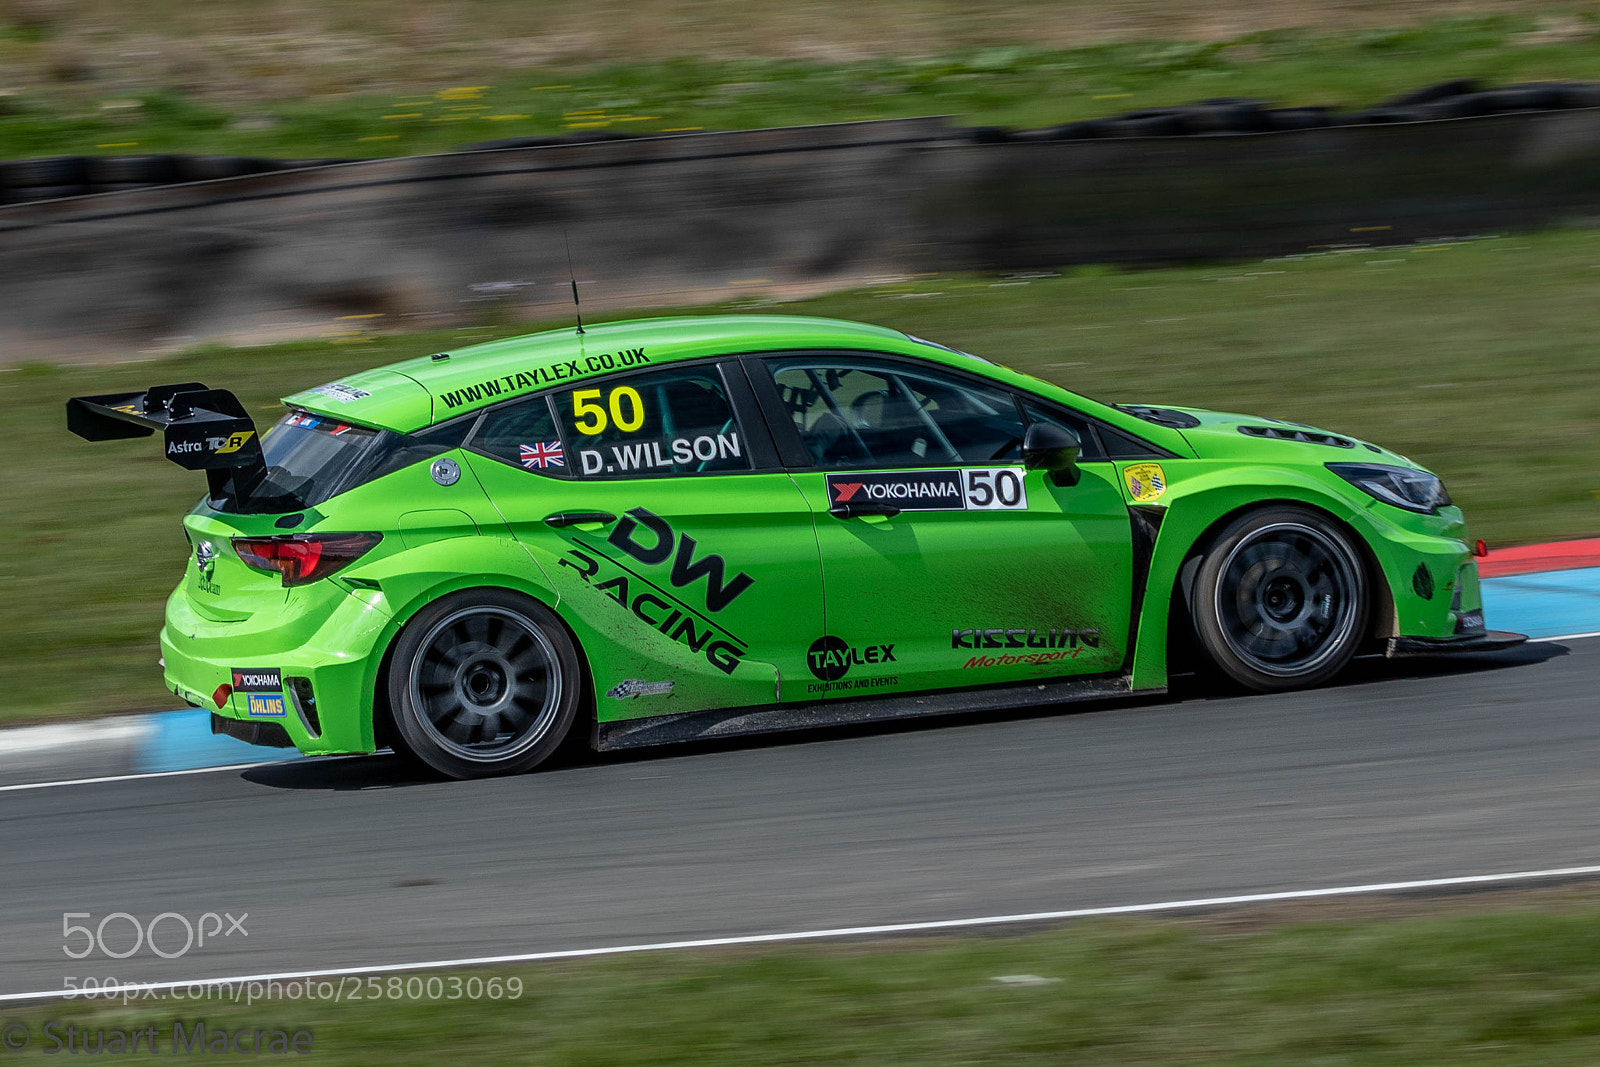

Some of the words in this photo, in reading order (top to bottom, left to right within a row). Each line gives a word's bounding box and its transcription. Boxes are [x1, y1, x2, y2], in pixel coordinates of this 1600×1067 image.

[440, 347, 650, 409] WWW.TAYLEX.CO.UK
[572, 386, 645, 435] 50
[168, 441, 202, 454] Astra
[580, 432, 741, 475] D.WILSON
[862, 482, 959, 499] YOKOHAMA
[968, 470, 1021, 507] 50
[607, 507, 755, 613] DW
[557, 550, 746, 675] RACING
[951, 628, 1100, 649] KISSLING
[810, 644, 897, 669] TAYLEX
[963, 647, 1085, 670] Motorsport
[242, 674, 280, 686] YOKOHAMA
[807, 680, 852, 693] EXHIBITIONS
[854, 678, 869, 688] AND
[870, 676, 898, 687] EVENTS
[250, 695, 283, 714] ÖHLINS
